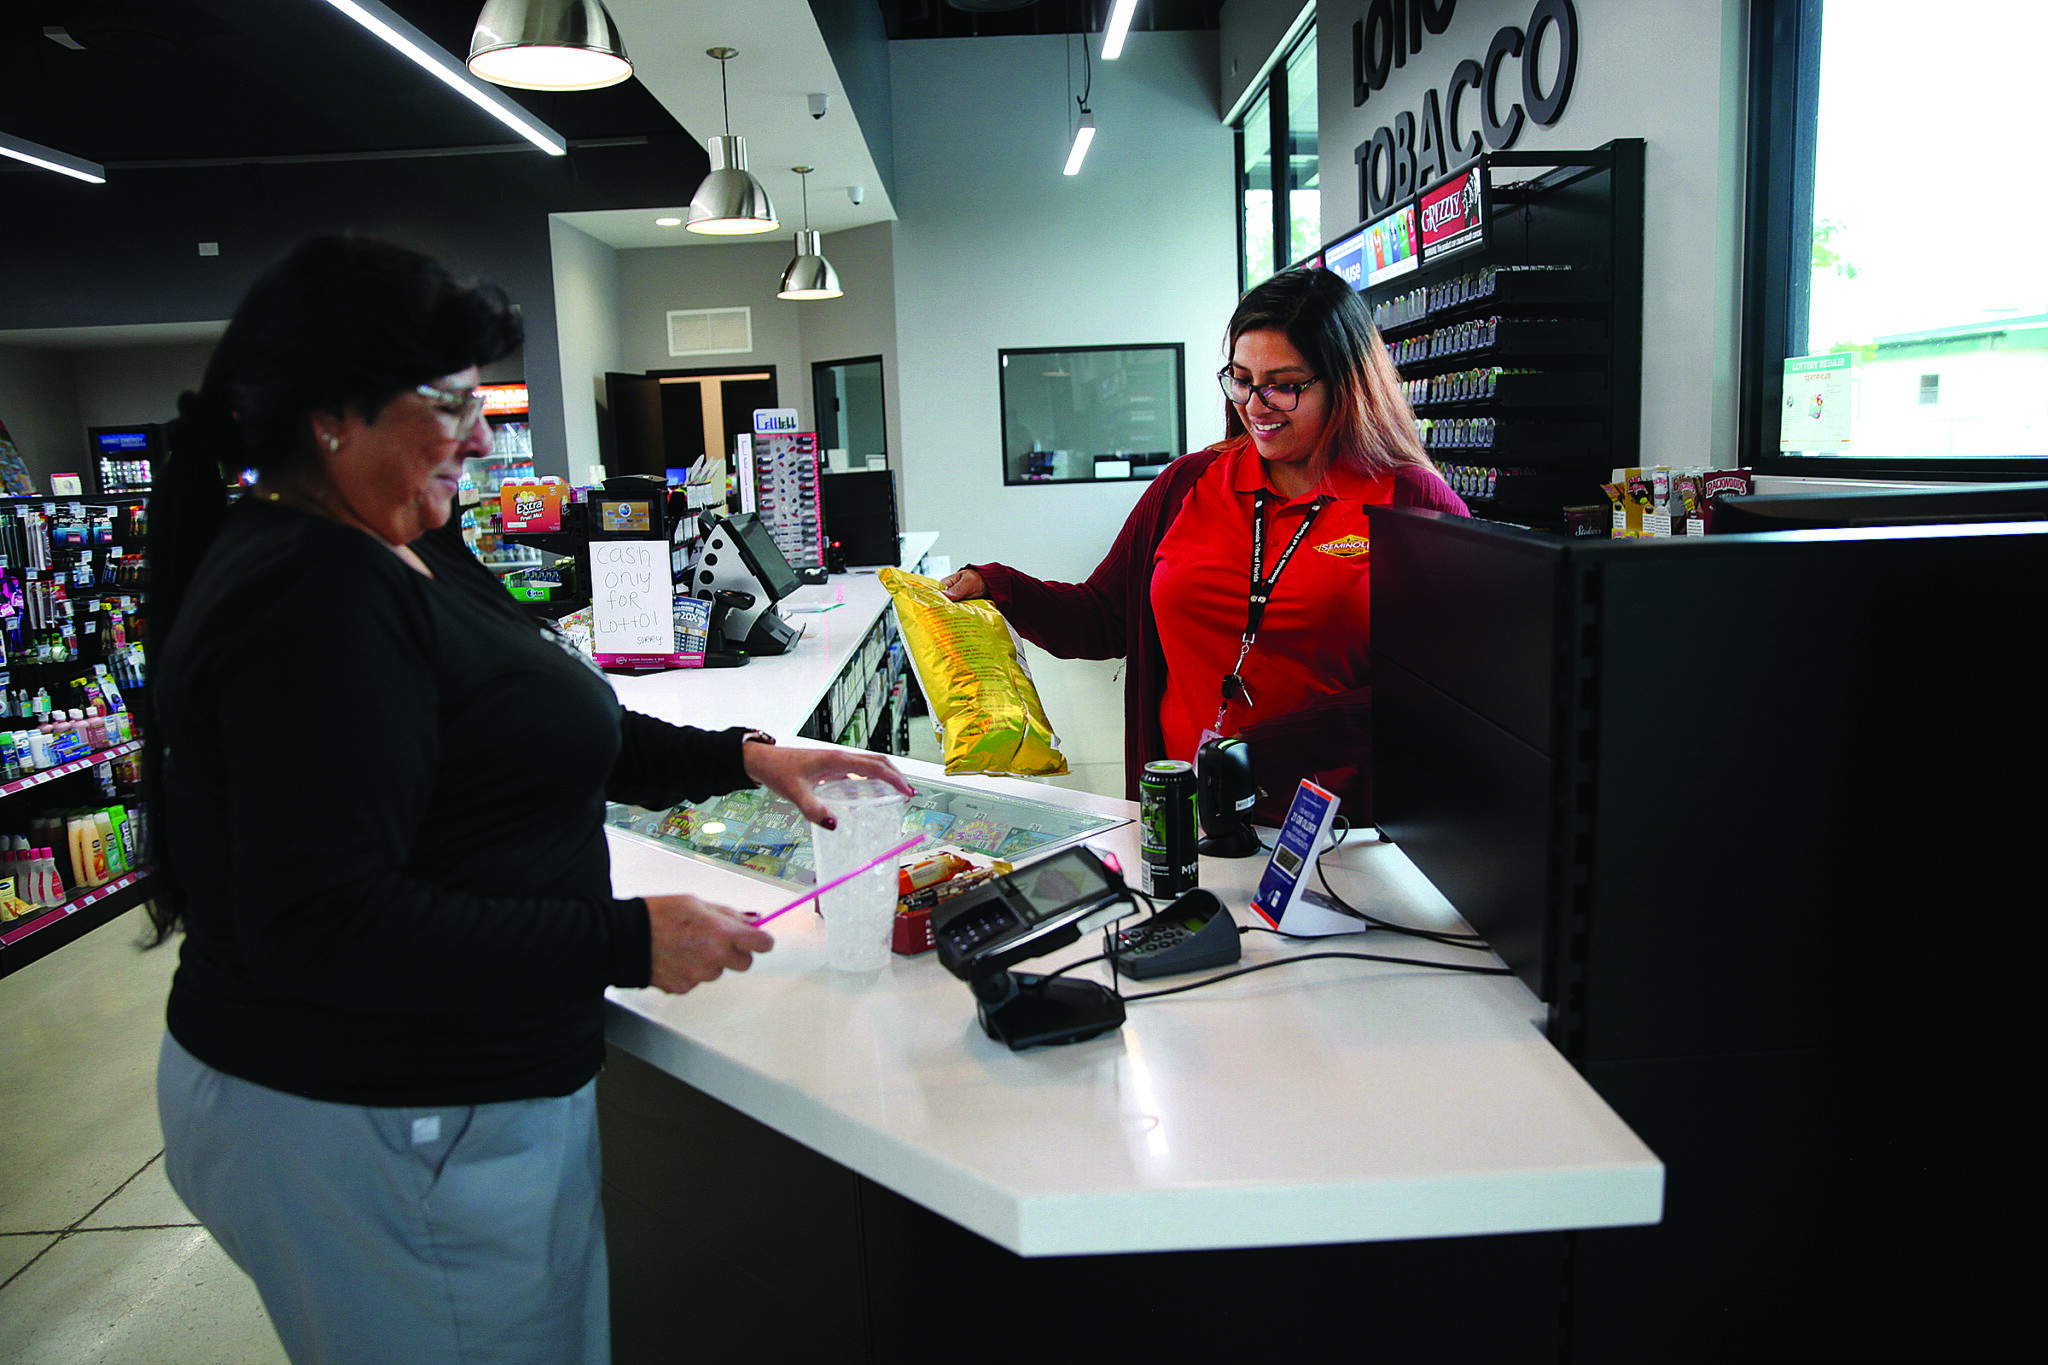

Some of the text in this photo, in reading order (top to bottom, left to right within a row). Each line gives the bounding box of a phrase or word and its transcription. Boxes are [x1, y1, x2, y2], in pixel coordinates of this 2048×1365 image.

[1354, 0, 1578, 222] TOBACCO
[1421, 190, 1461, 233] GRIZZLY
[1792, 358, 1845, 371] LOTTERY RETAILER
[1705, 477, 1747, 499] BACKWOODS
[516, 500, 544, 515] Extra
[680, 611, 699, 623] 20X
